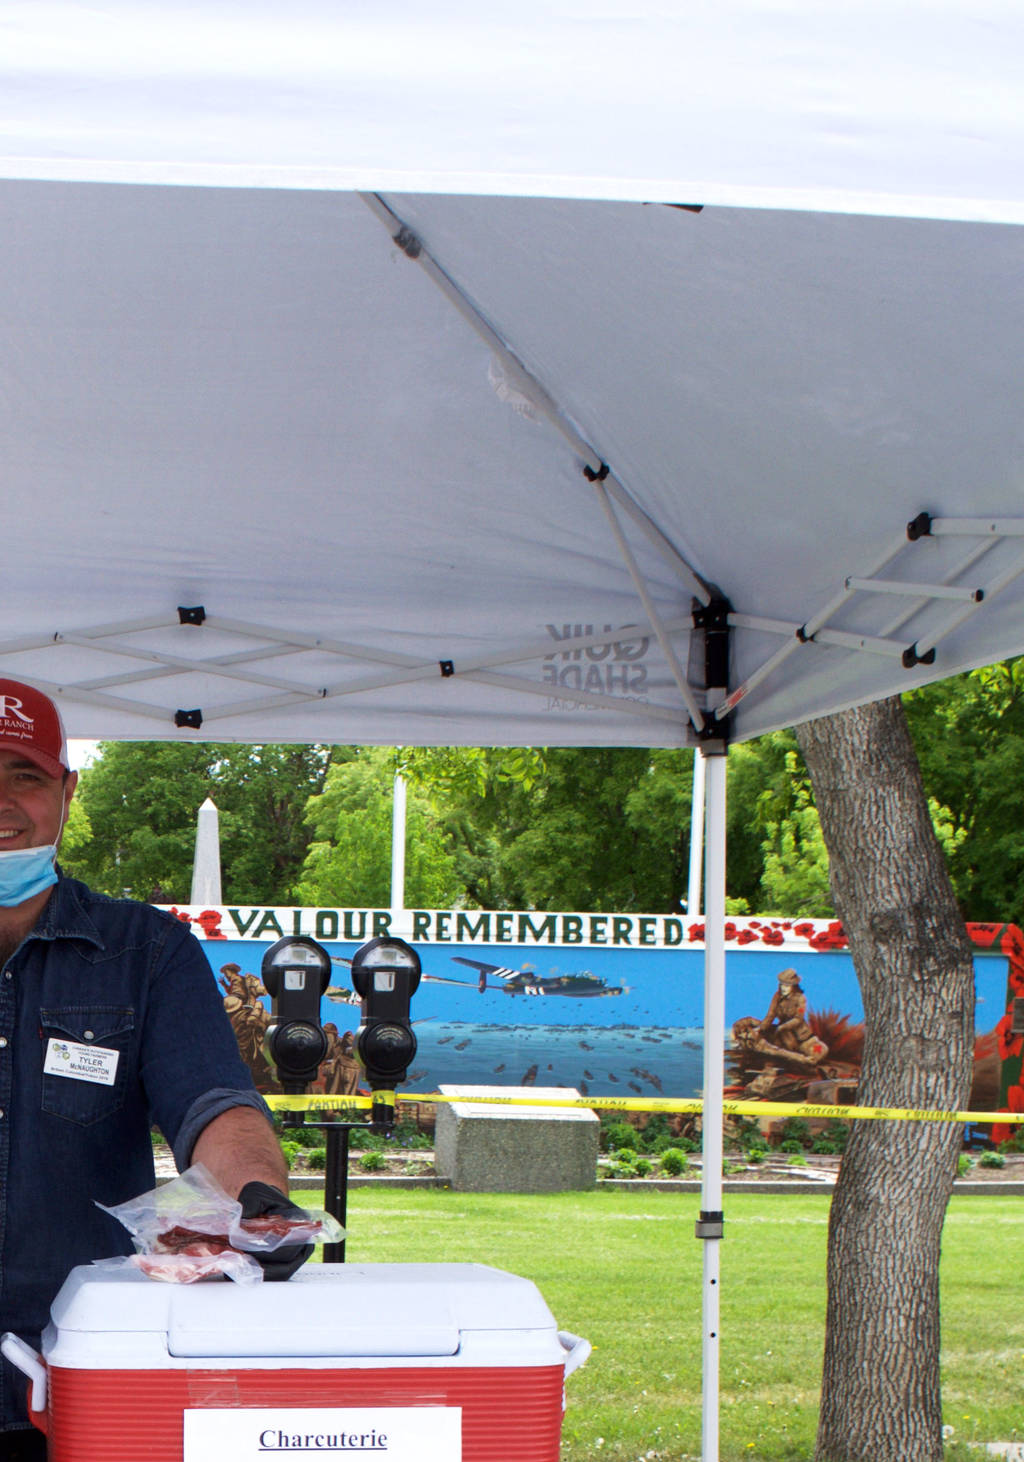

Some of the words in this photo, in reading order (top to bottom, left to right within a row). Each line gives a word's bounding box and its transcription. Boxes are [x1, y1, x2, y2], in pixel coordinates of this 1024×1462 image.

[4, 719, 34, 731] RANCH
[228, 909, 392, 938] VALOUR
[412, 911, 684, 946] REMEMBERED
[79, 1056, 103, 1066] TYLER
[258, 1429, 389, 1451] Charcuterie
